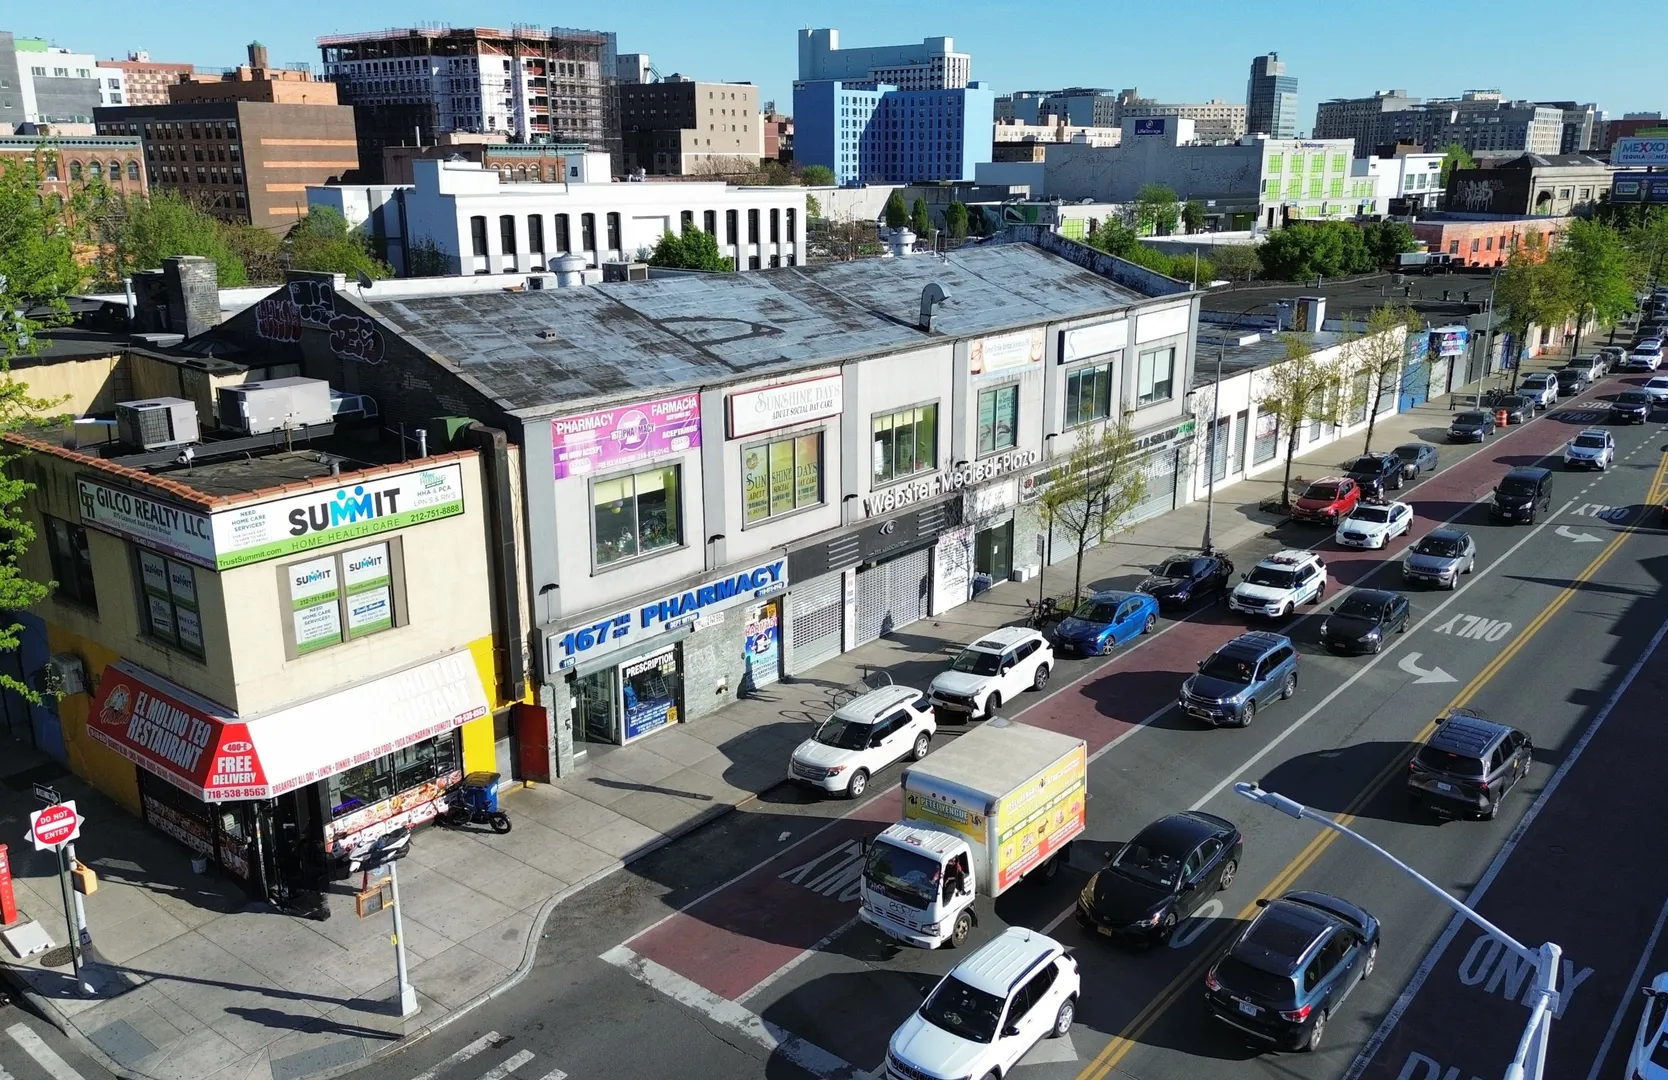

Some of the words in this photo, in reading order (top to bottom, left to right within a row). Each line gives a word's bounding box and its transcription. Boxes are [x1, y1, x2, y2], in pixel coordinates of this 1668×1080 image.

[755, 389, 812, 413] SUNSHINE
[816, 384, 840, 400] DAYS
[556, 413, 614, 435] PHARMACY
[651, 397, 698, 416] FARMACIA
[772, 408, 789, 420] ADULT
[790, 405, 808, 415] SOCIAL
[809, 403, 820, 412] DAY
[820, 400, 833, 409] CARE
[622, 423, 656, 441] PHAMACY
[797, 462, 818, 478] DAYS
[868, 482, 934, 517] Webster
[942, 458, 996, 493] Medical
[1004, 450, 1036, 473] Plaza
[96, 487, 131, 515] GILCO
[135, 500, 178, 530] REALTY
[182, 513, 210, 540] LLC.
[232, 518, 249, 526] HOME
[250, 514, 266, 523] CARE
[288, 486, 400, 536] SUMMIT
[410, 504, 460, 522] 212-751-8888
[1570, 502, 1630, 522] ONLY
[234, 521, 266, 532] SERVICES?
[292, 537, 323, 550] HOME
[328, 526, 369, 541] HEALTH
[373, 518, 400, 531] CARE
[219, 547, 282, 567] TrustSummit.com
[349, 556, 382, 572] SUMMIT
[144, 563, 163, 578] SUMMIT
[296, 569, 331, 586] SUMMIT
[172, 574, 192, 589] SUMMIT
[318, 609, 331, 617] CARE
[559, 621, 612, 656] 167
[612, 613, 630, 626] TH
[641, 560, 784, 629] PHARMACY
[304, 615, 331, 626] SERVICES?
[1432, 612, 1513, 642] ONLY
[612, 625, 630, 639] ST
[626, 651, 674, 679] PRESCRIPTION
[135, 691, 144, 714] EL
[145, 699, 190, 737] MOLINO
[188, 717, 212, 748] TEO
[126, 714, 202, 772] RESTAURANT
[227, 742, 248, 751] 400-E
[217, 756, 252, 773] FREE
[272, 778, 298, 795] BREAKFAST
[298, 775, 306, 786] ALL
[306, 772, 315, 784] DAY
[318, 765, 332, 779] LUNCH
[335, 758, 351, 773] DINNER
[354, 751, 370, 764] BURGER
[381, 743, 392, 753] FOOD
[395, 737, 406, 749] YUCA
[406, 727, 430, 744] CHICHARRON
[212, 772, 257, 786] DELIVERY
[207, 788, 266, 799] 718-538-8563
[40, 815, 51, 824] DO
[53, 810, 68, 820] NOT
[44, 827, 69, 840] ENTER
[1458, 934, 1595, 1020] ONY
